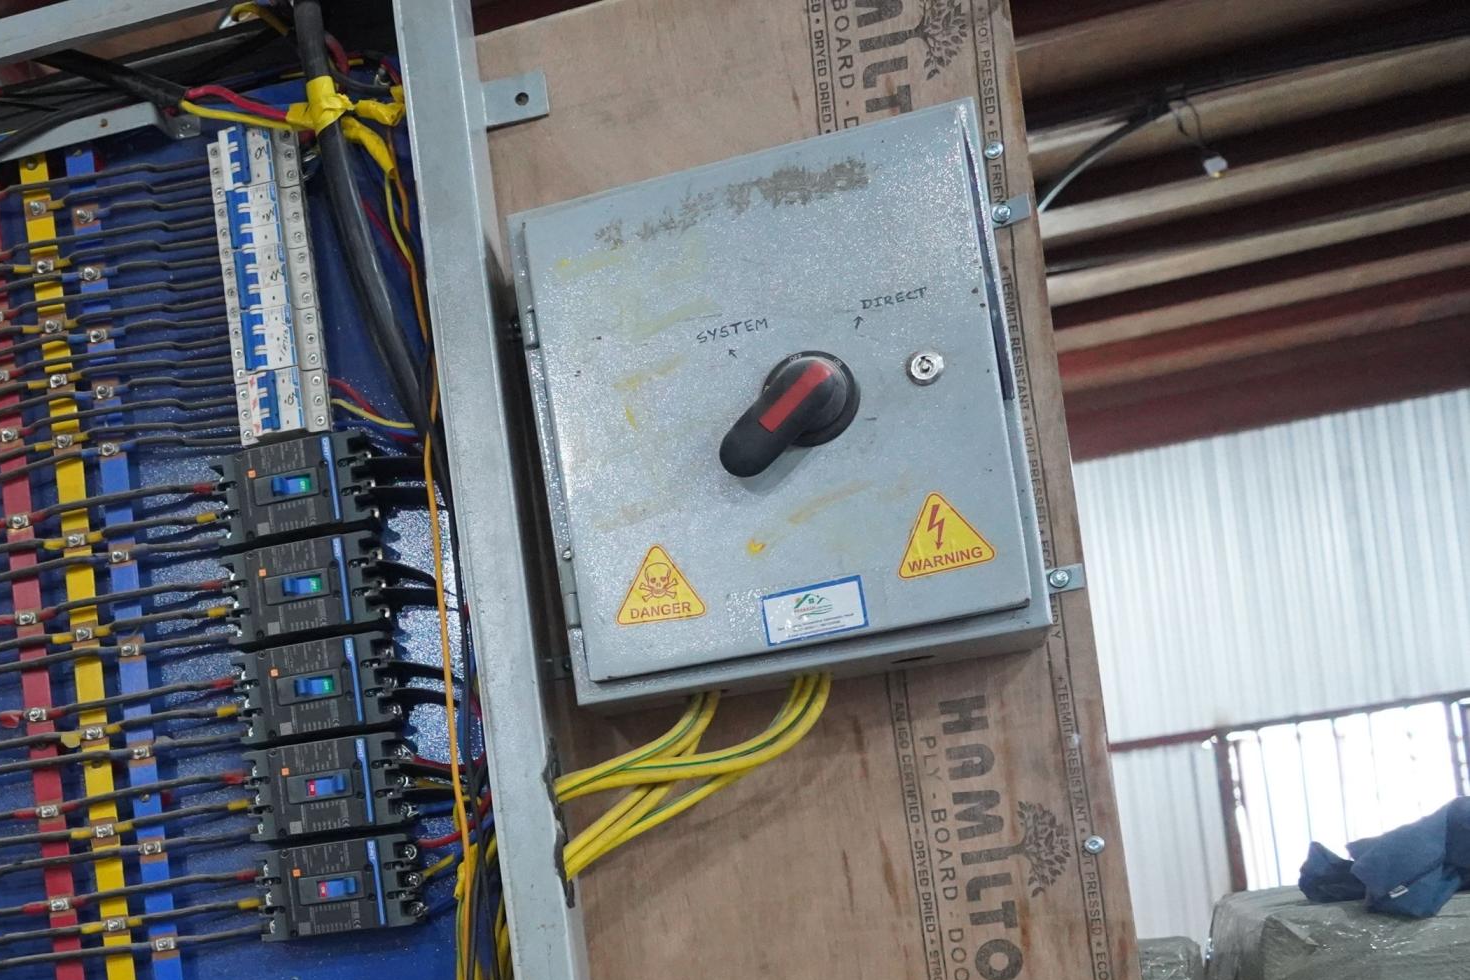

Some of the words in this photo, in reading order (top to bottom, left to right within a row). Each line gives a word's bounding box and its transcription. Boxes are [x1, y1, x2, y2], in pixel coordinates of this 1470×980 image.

[814, 30, 827, 77] DRYED
[818, 82, 832, 124] DRIED
[981, 51, 995, 115] PRESSED
[859, 286, 928, 310] DIRECT
[696, 317, 769, 344] SYSTEM
[908, 546, 983, 573] WARNING
[631, 601, 691, 619] DANGER
[1058, 684, 1075, 746] TERMITE
[1064, 748, 1088, 824] RESISTANT
[915, 841, 929, 886] DRYED
[932, 808, 958, 901] BOARD
[921, 891, 936, 934] DRIED
[1085, 872, 1103, 936] PRESSED
